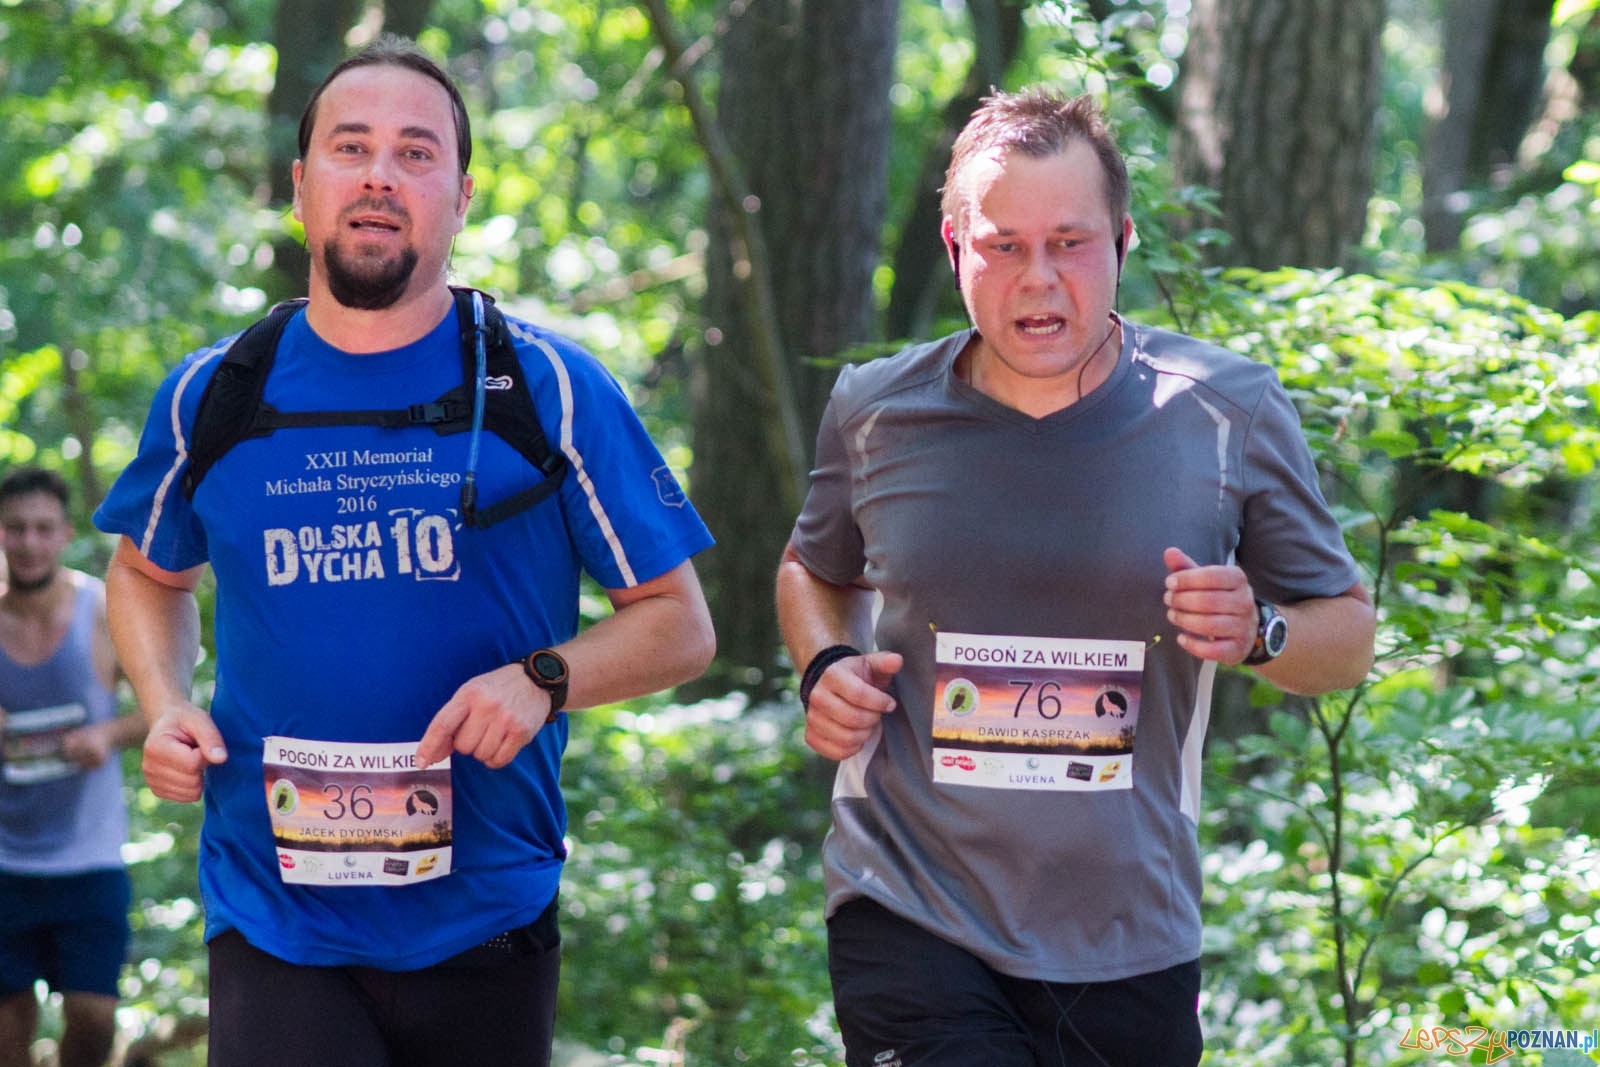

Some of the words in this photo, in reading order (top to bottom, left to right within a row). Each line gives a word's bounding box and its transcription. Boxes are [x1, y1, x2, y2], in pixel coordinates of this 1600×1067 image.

[305, 451, 347, 470] XXII
[353, 447, 433, 466] Memoriał
[265, 476, 332, 496] Michała
[336, 468, 461, 493] Stryczyńskiego
[336, 495, 378, 514] 2016
[390, 514, 455, 575] 10
[954, 644, 1017, 664] POGOŃ
[1022, 650, 1046, 664] ZA
[1051, 651, 1128, 667] WILKIEM
[1008, 680, 1062, 720] 76
[978, 726, 1019, 738] DAWID
[1022, 728, 1090, 740] KASPRZAK
[279, 748, 328, 768] POGOŃ
[333, 755, 356, 769] ZA
[360, 755, 418, 769] WILKIE
[1009, 775, 1056, 784] LUVENA
[322, 783, 374, 820] 36
[299, 826, 336, 838] JACEK
[339, 828, 403, 839] DYDYMSKI
[327, 871, 374, 880] LUVENA
